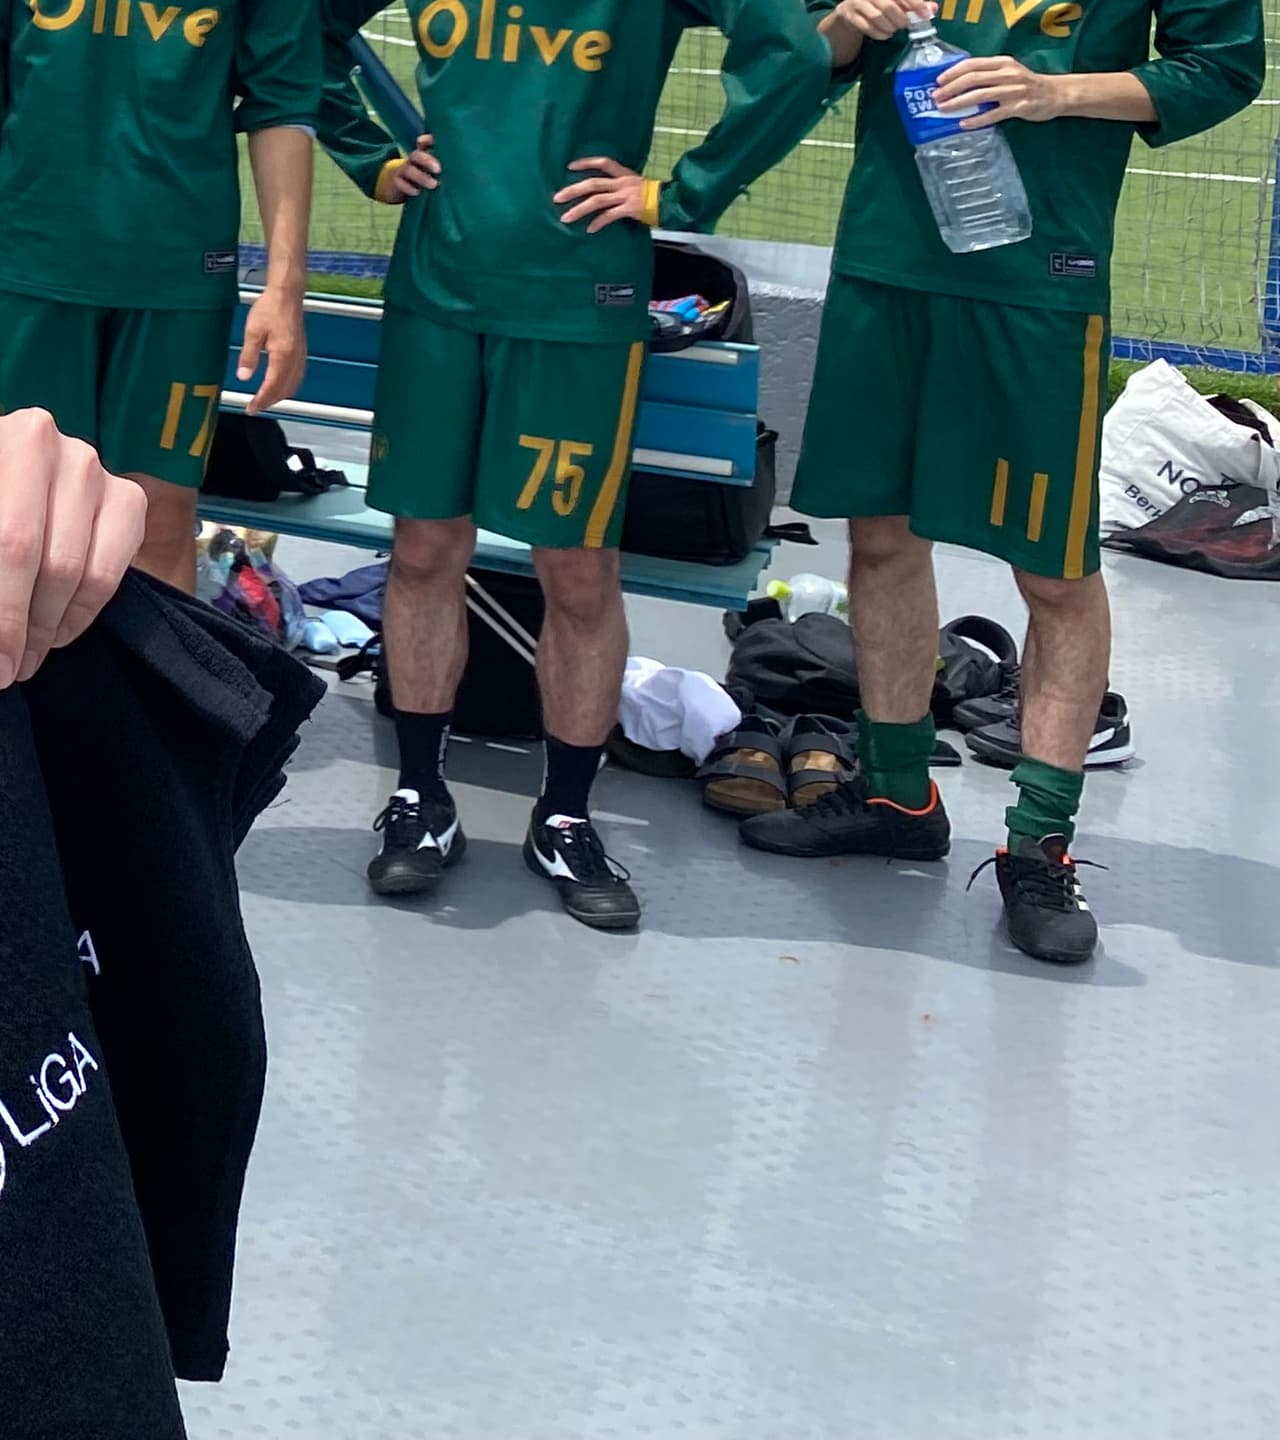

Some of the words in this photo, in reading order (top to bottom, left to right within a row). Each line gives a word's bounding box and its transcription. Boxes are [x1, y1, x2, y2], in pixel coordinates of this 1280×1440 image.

[159, 382, 219, 456] 17
[515, 434, 593, 516] 75
[990, 457, 1049, 542] 11
